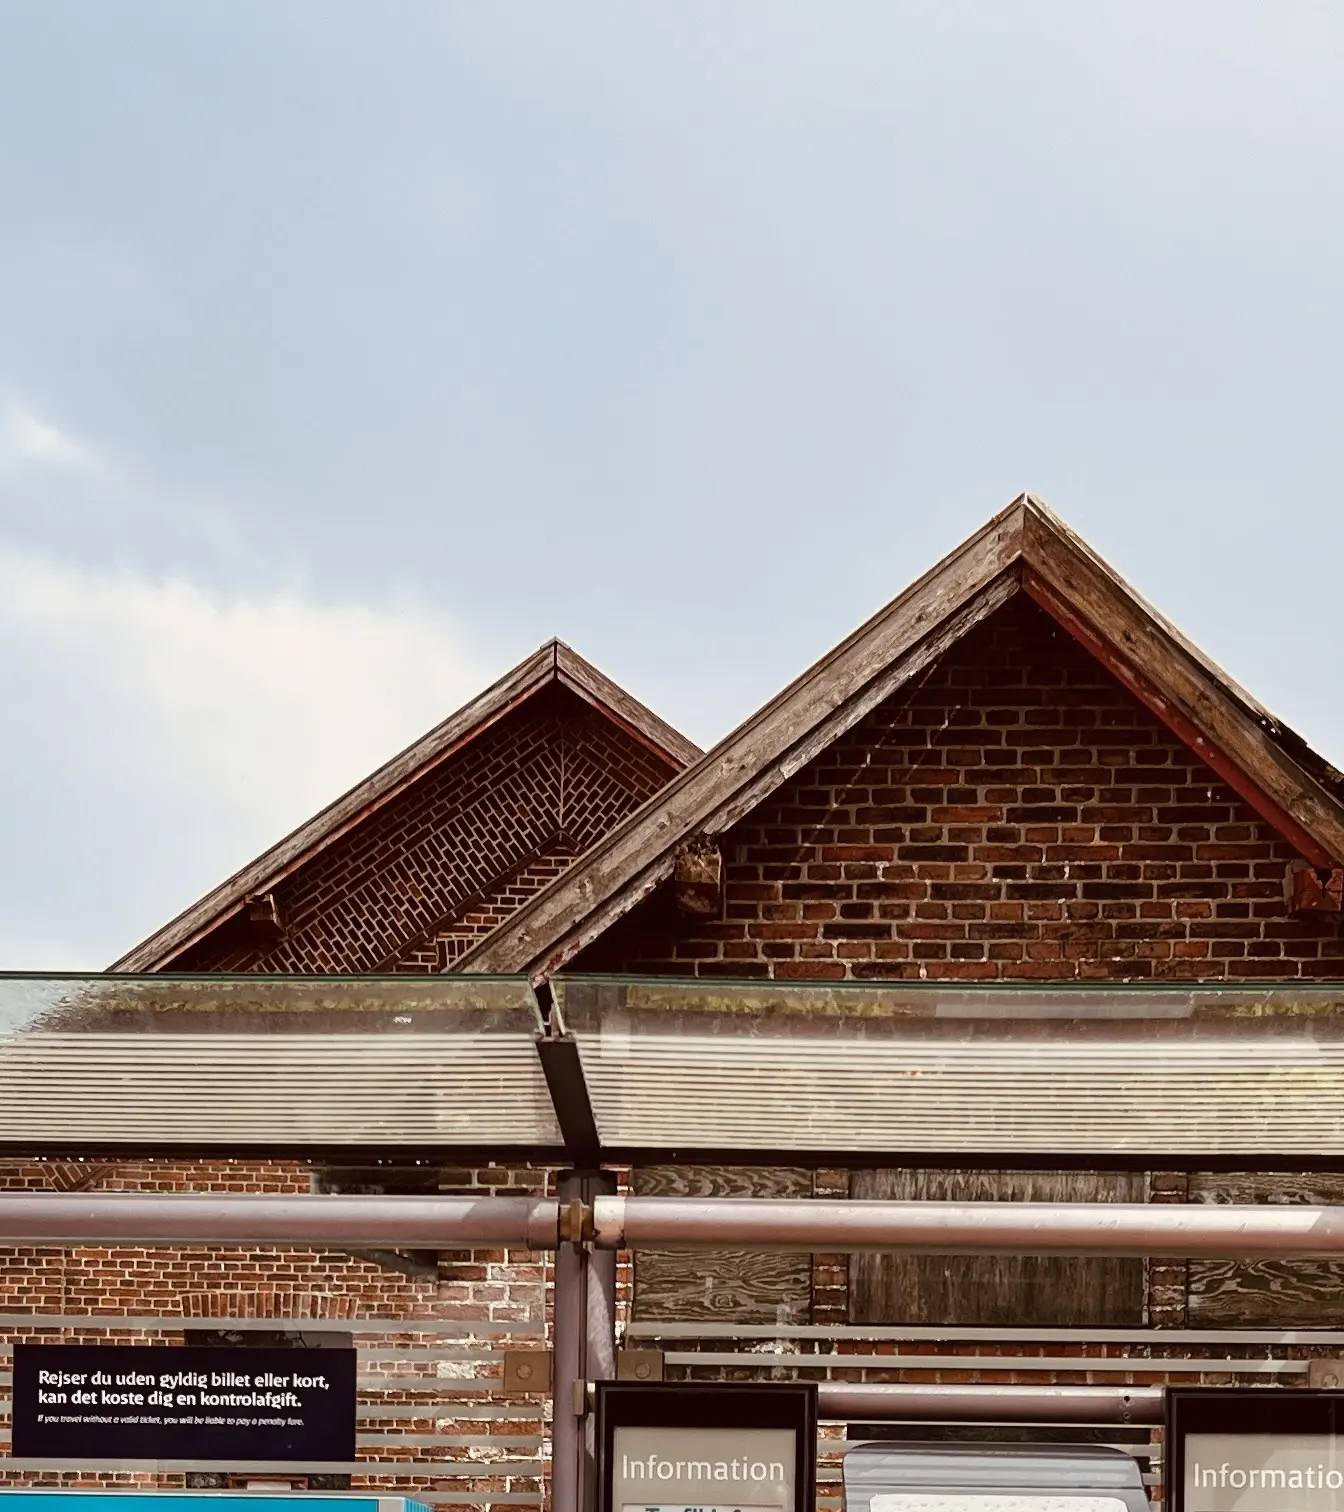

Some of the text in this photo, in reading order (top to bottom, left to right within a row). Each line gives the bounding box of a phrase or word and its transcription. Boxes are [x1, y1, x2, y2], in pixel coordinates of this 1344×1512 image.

[39, 1370, 329, 1389] Rejser du uden gyldig billet eller kort,
[38, 1390, 302, 1409] kan det koste dig en kontrolafgift.
[44, 1416, 59, 1424] you
[164, 1417, 178, 1426] you
[194, 1416, 204, 1425] be
[236, 1418, 250, 1427] pay
[623, 1454, 784, 1481] Information
